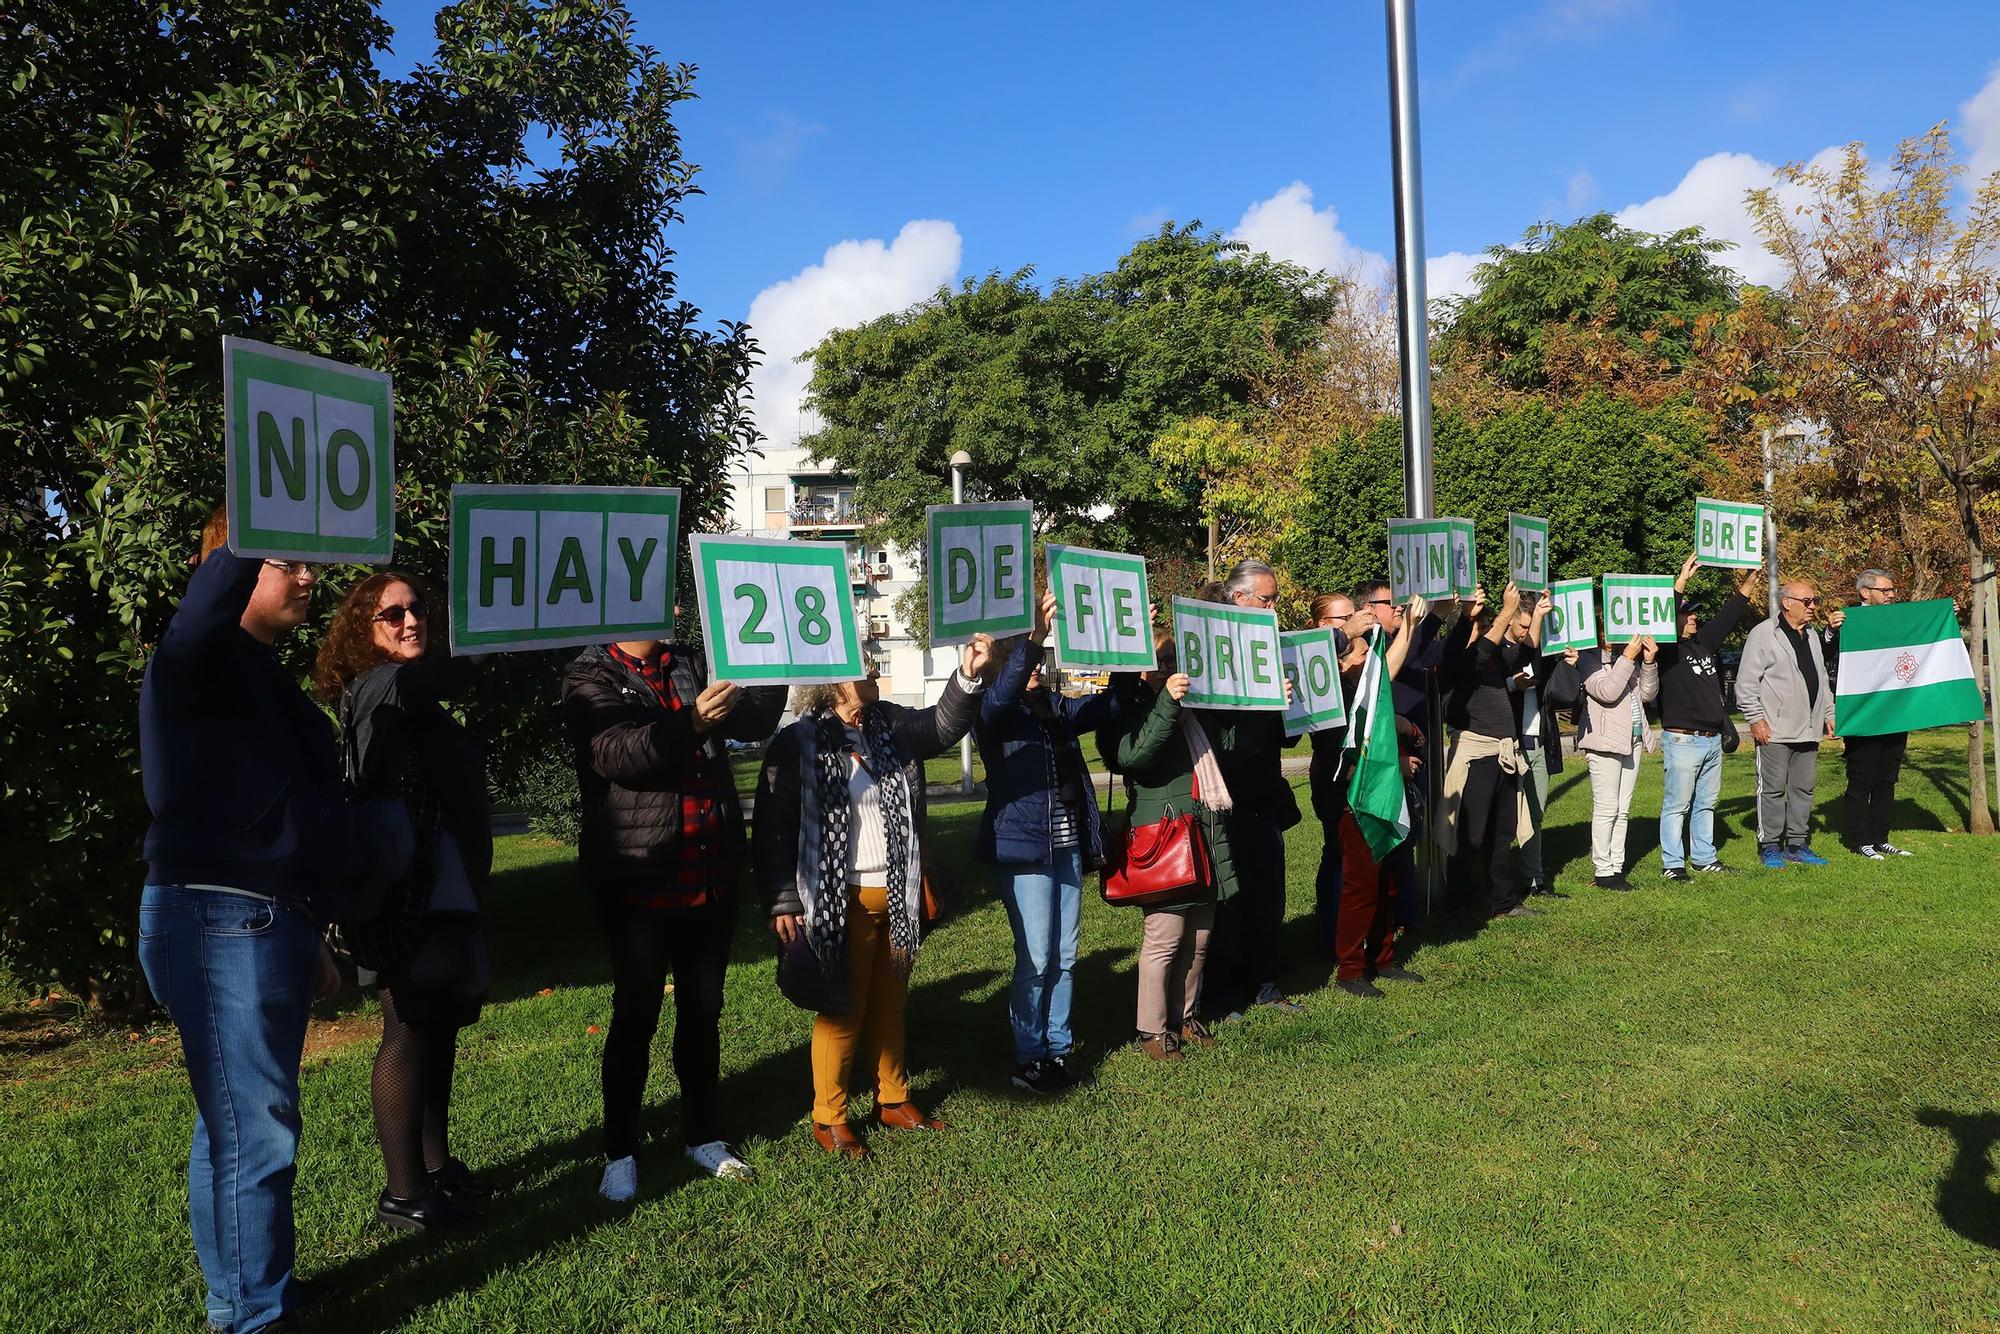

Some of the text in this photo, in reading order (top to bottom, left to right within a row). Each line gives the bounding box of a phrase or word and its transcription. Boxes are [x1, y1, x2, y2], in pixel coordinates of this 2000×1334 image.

[258, 411, 370, 510] NO
[1514, 537, 1541, 573] DE
[1702, 520, 1757, 552] BRE
[480, 537, 658, 607] HAY
[949, 544, 1015, 604] DE
[1395, 543, 1445, 585] SIN
[733, 583, 831, 645] 28
[1074, 584, 1136, 637] FE
[1548, 601, 1584, 636] DI
[1610, 596, 1675, 626] CIEM
[1183, 631, 1272, 684] BRE
[1283, 655, 1331, 703] RO
